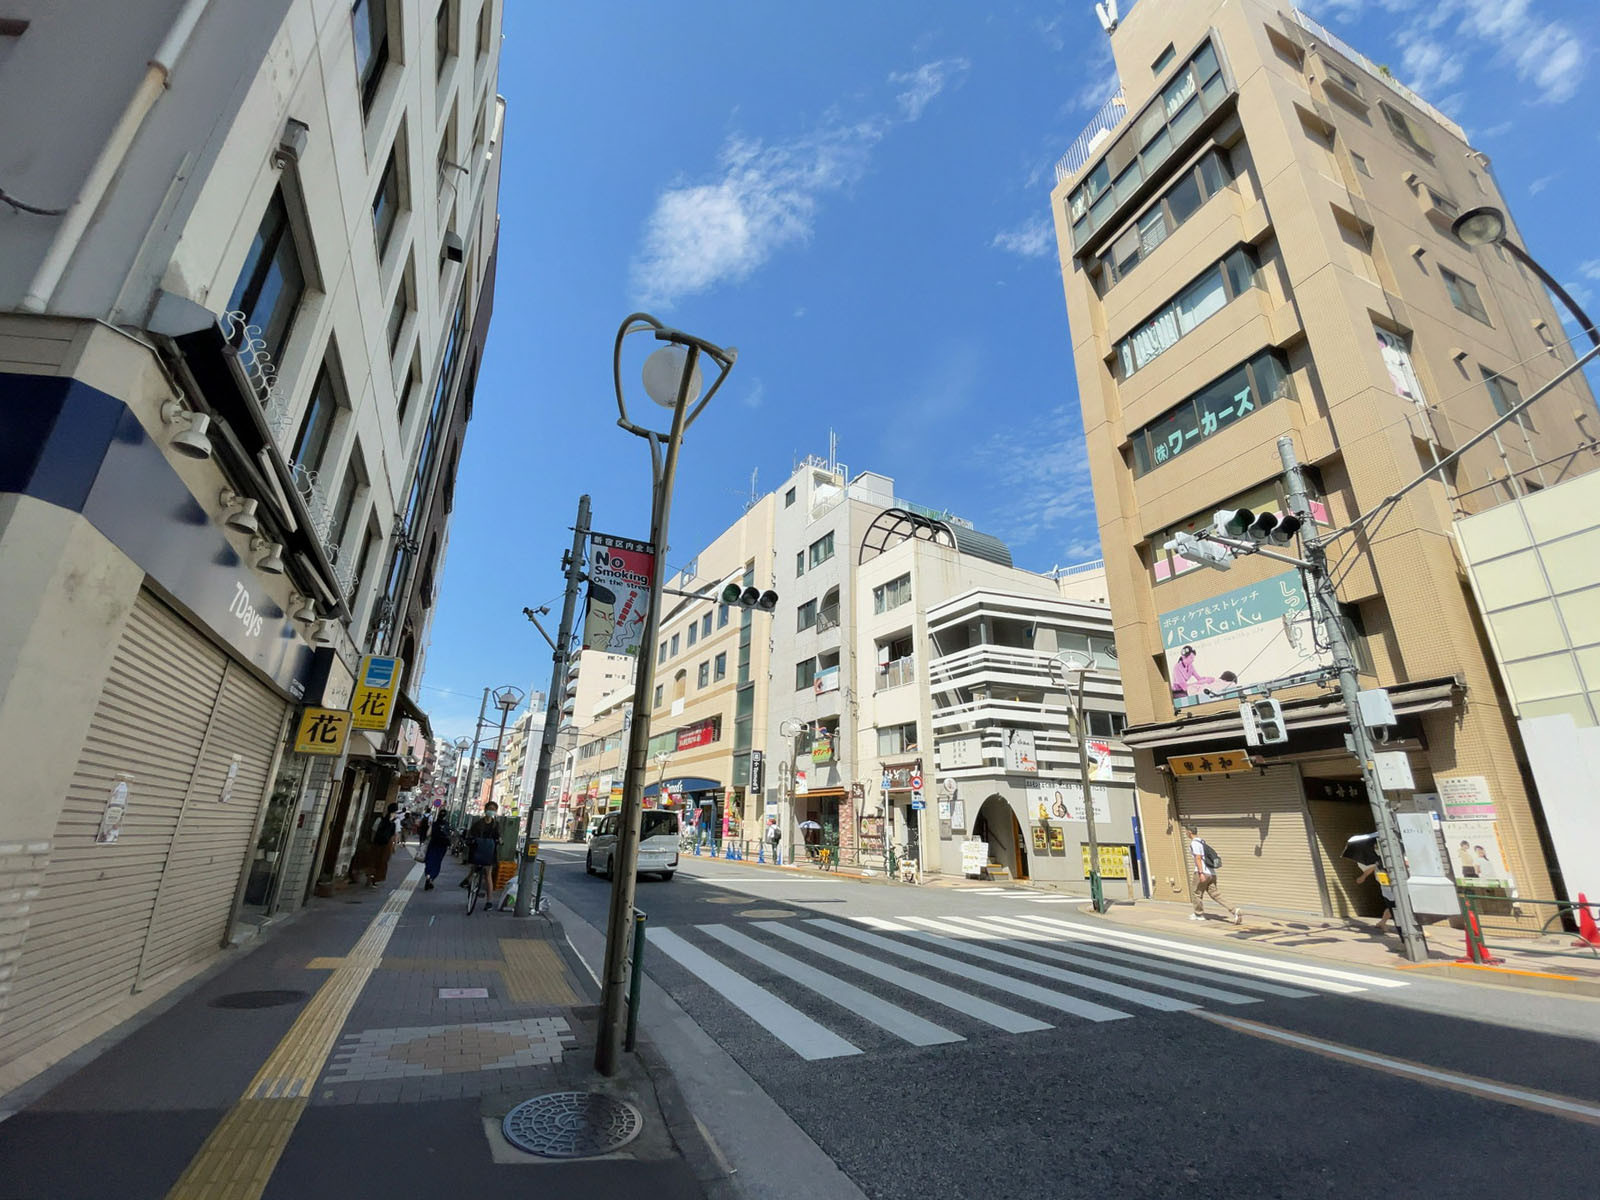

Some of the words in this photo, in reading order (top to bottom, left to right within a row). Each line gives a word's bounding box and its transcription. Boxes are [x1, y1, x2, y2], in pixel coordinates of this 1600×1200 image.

[595, 550, 625, 569] No
[593, 576, 606, 584] On
[609, 578, 624, 587] the
[626, 582, 650, 593] street
[594, 565, 649, 586] Smoking
[228, 581, 263, 637] 7Days
[358, 691, 389, 717] 花
[306, 714, 343, 744] 花
